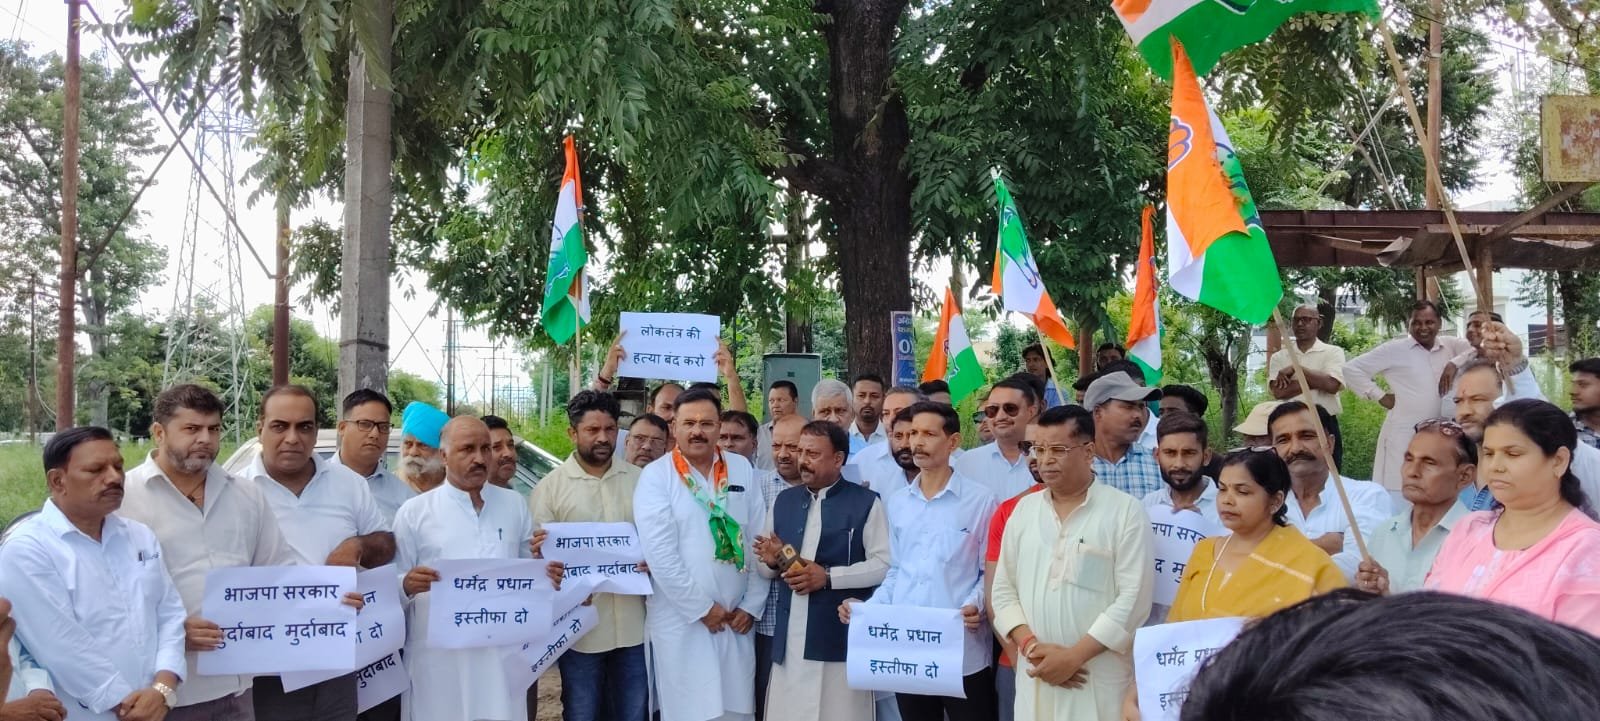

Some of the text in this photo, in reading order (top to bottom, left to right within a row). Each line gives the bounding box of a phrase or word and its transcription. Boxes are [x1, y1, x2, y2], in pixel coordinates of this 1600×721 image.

[640, 324, 702, 340] लोकतंत्र की
[633, 352, 706, 367] हत्या बंद करो
[556, 536, 631, 550] भाजपा सरकार
[496, 578, 535, 591] प्रधान
[224, 584, 340, 602] भाजपा सरकार
[454, 608, 528, 627] इस्तीफा दो
[284, 618, 348, 646] मुर्दाबाद
[369, 622, 383, 640] दो
[569, 618, 582, 634] दो
[906, 629, 942, 644] प्रधान
[870, 658, 939, 679] इस्तीफा दो
